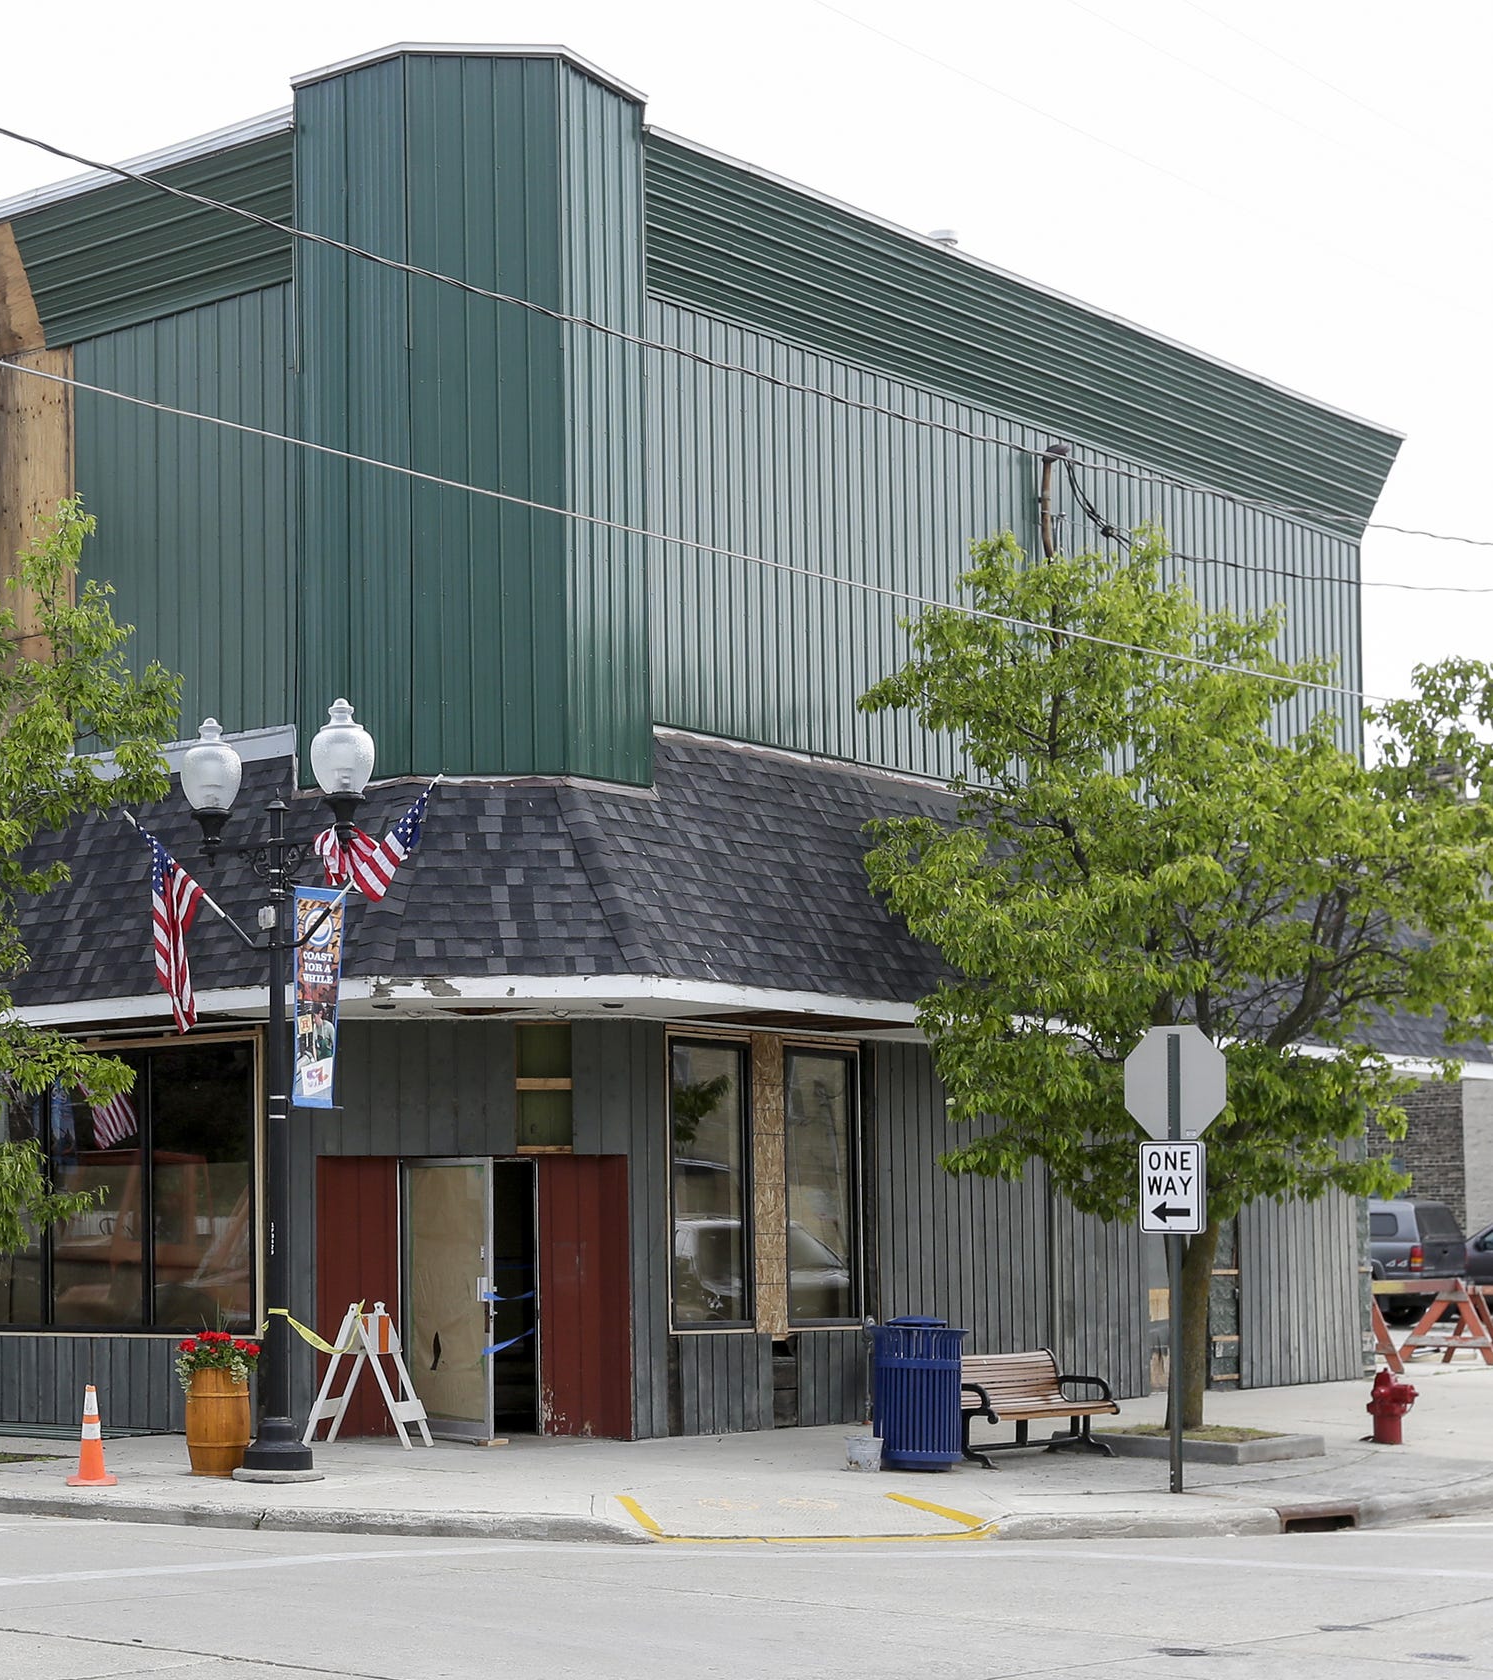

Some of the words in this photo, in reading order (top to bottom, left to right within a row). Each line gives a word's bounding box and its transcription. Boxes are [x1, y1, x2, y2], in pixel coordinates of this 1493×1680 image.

[303, 951, 333, 962] COAST
[324, 964, 331, 973] A
[303, 973, 333, 984] WHILE
[1148, 1151, 1192, 1171] ONE
[1147, 1176, 1193, 1196] WAY
